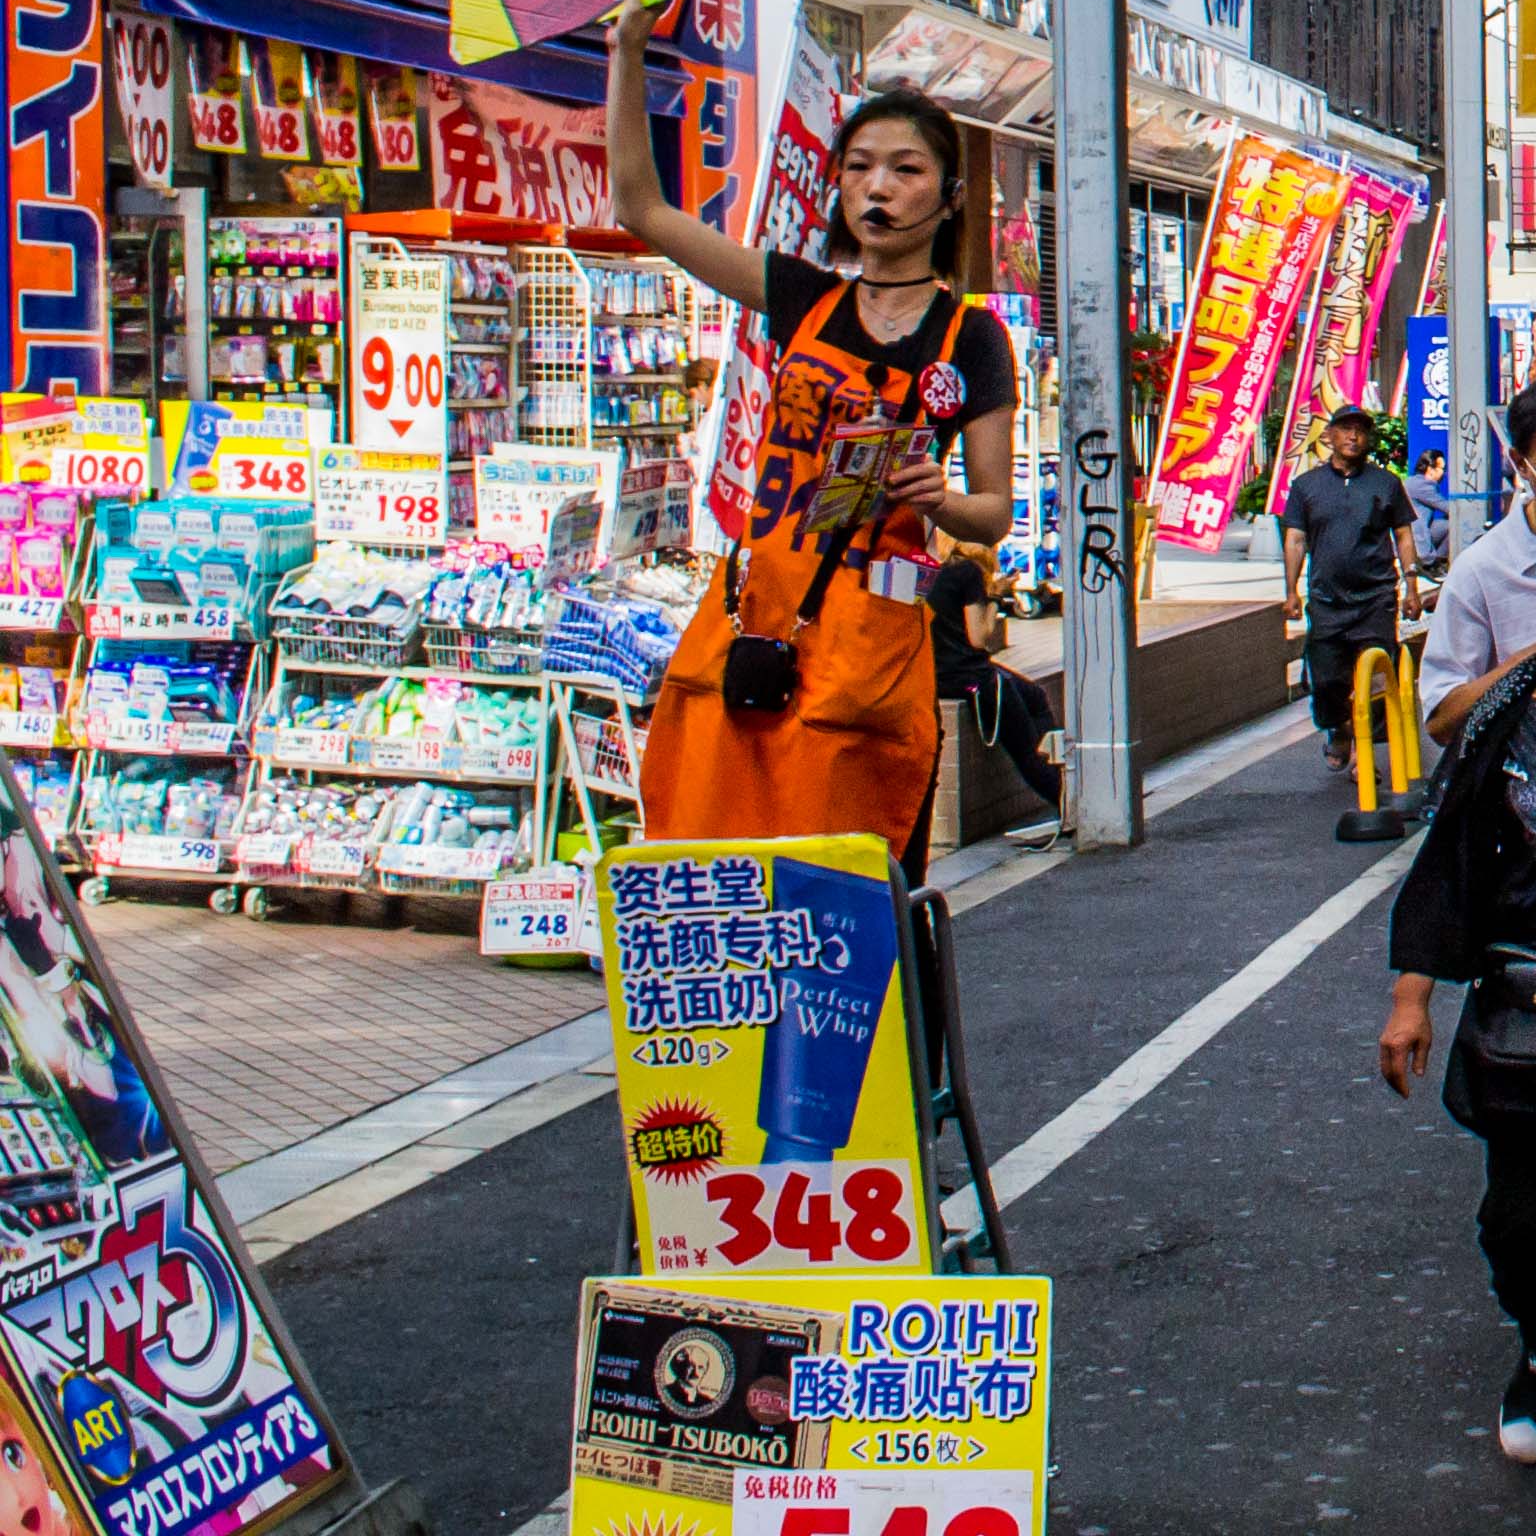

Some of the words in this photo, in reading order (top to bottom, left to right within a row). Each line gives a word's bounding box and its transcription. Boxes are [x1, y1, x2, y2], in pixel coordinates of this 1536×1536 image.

[438, 102, 562, 226] 免税
[361, 268, 442, 291] 営業時間
[361, 300, 407, 314] Business
[410, 300, 439, 314] hours
[1166, 152, 1308, 473] 特選品フェア
[362, 336, 444, 412] 9:00
[67, 453, 145, 487] 1080
[235, 458, 308, 494] 348
[376, 494, 440, 524] 198
[18, 597, 56, 618] 427
[122, 610, 189, 628] 休足時間
[193, 608, 231, 629] 458
[14, 715, 52, 735] 1480
[318, 732, 346, 753] 298
[416, 740, 441, 761] 198
[507, 747, 534, 769] 698
[179, 840, 217, 861] 598
[610, 858, 766, 915] 资生堂
[520, 914, 569, 937] 248
[617, 909, 822, 973] 洗颜专科
[622, 970, 783, 1033] 洗面奶
[779, 978, 871, 1017] Perfect
[798, 1005, 869, 1043] Whip
[634, 1122, 724, 1166] 超特价
[706, 1168, 911, 1266] 348
[658, 1235, 688, 1251] 免税
[6, 1240, 179, 1367] マクロス
[118, 1161, 240, 1400] 3
[851, 1302, 1038, 1356] ROIHI
[790, 1357, 1037, 1423] 酸痛贴布
[71, 1401, 124, 1456] ART
[108, 1392, 320, 1536] マクロスフロンティア3
[743, 1474, 838, 1501] 免税价格
